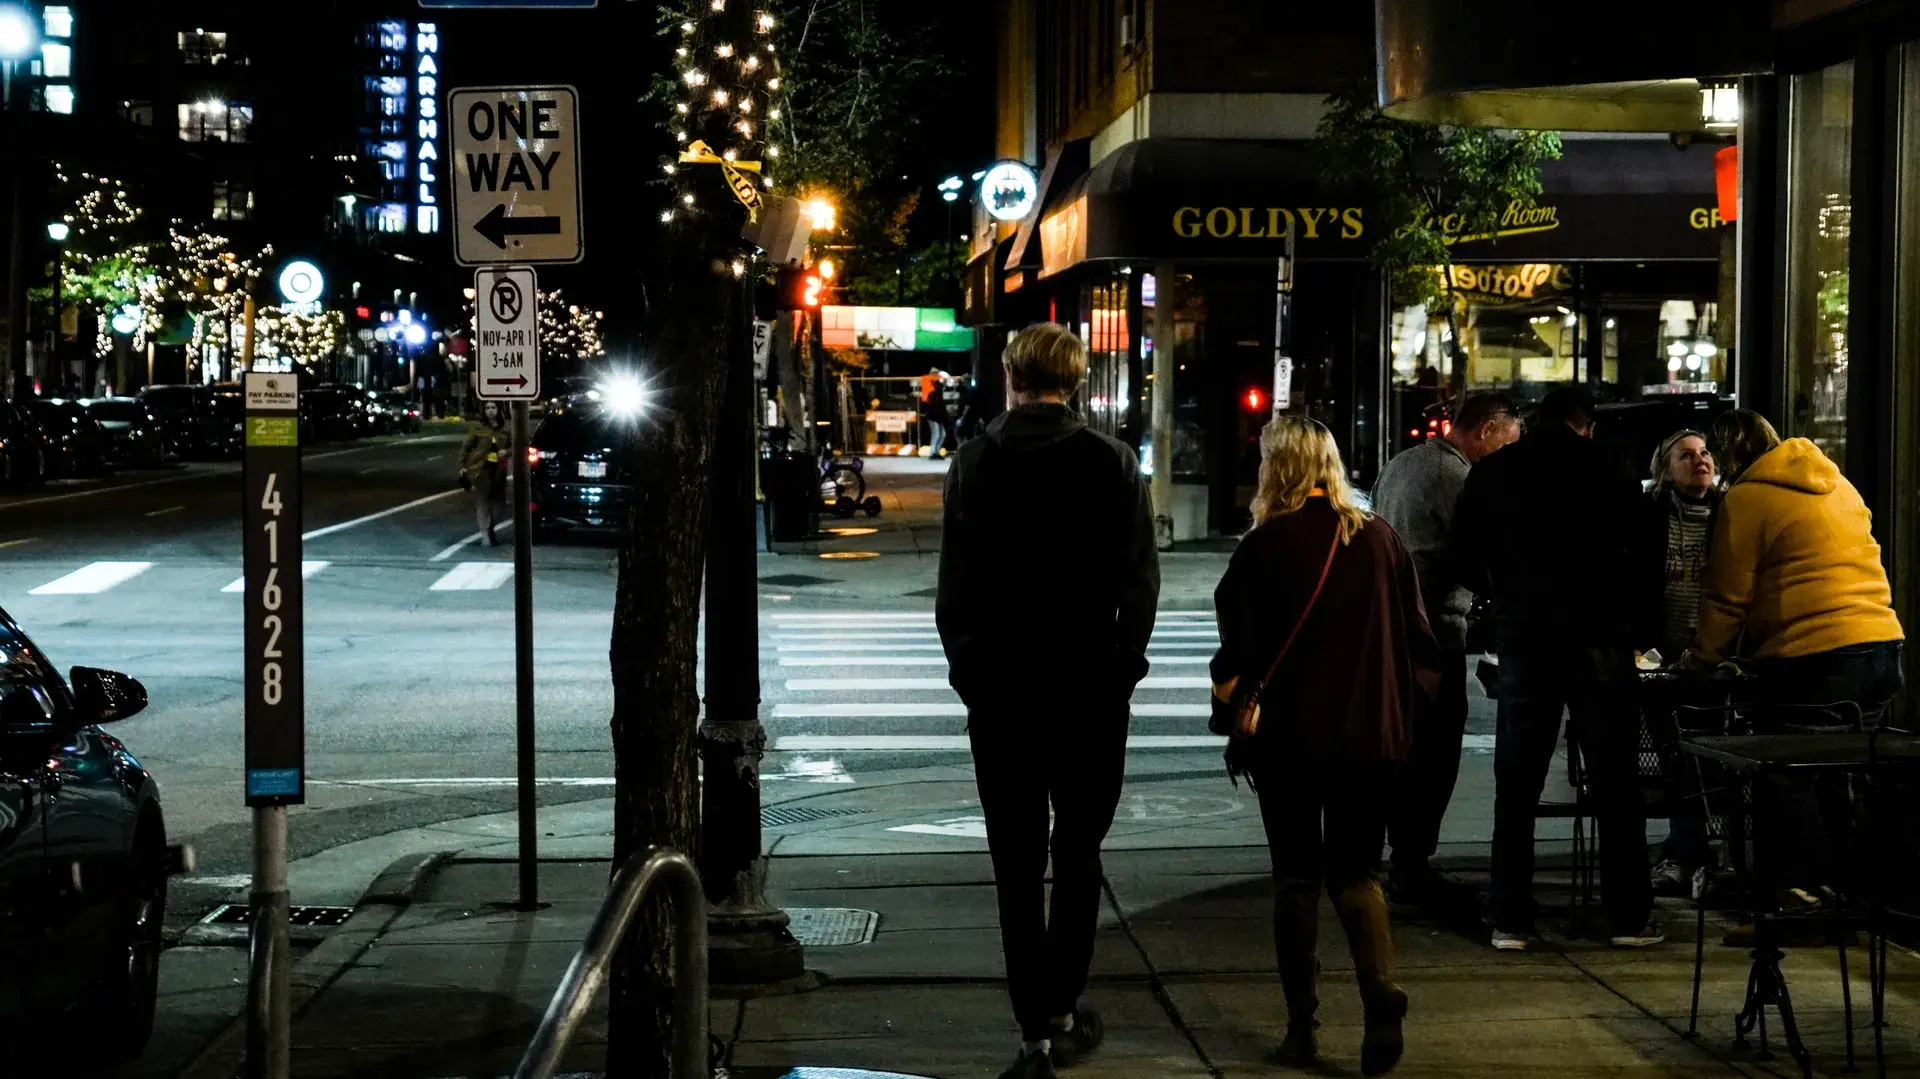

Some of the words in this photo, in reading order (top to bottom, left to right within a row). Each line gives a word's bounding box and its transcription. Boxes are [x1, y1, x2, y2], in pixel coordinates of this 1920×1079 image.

[417, 33, 438, 203] MARSHALL
[468, 101, 560, 141] ONE
[466, 152, 561, 192] WAY
[1172, 206, 1364, 239] GOLDY'S
[1501, 200, 1558, 227] Room
[482, 330, 524, 346] NOV-APR
[492, 352, 523, 368] 3-6AM
[248, 391, 262, 399] PAY
[264, 391, 296, 399] PARKING
[254, 418, 267, 435] 2
[268, 419, 292, 427] HOUR
[261, 472, 283, 706] 41628
